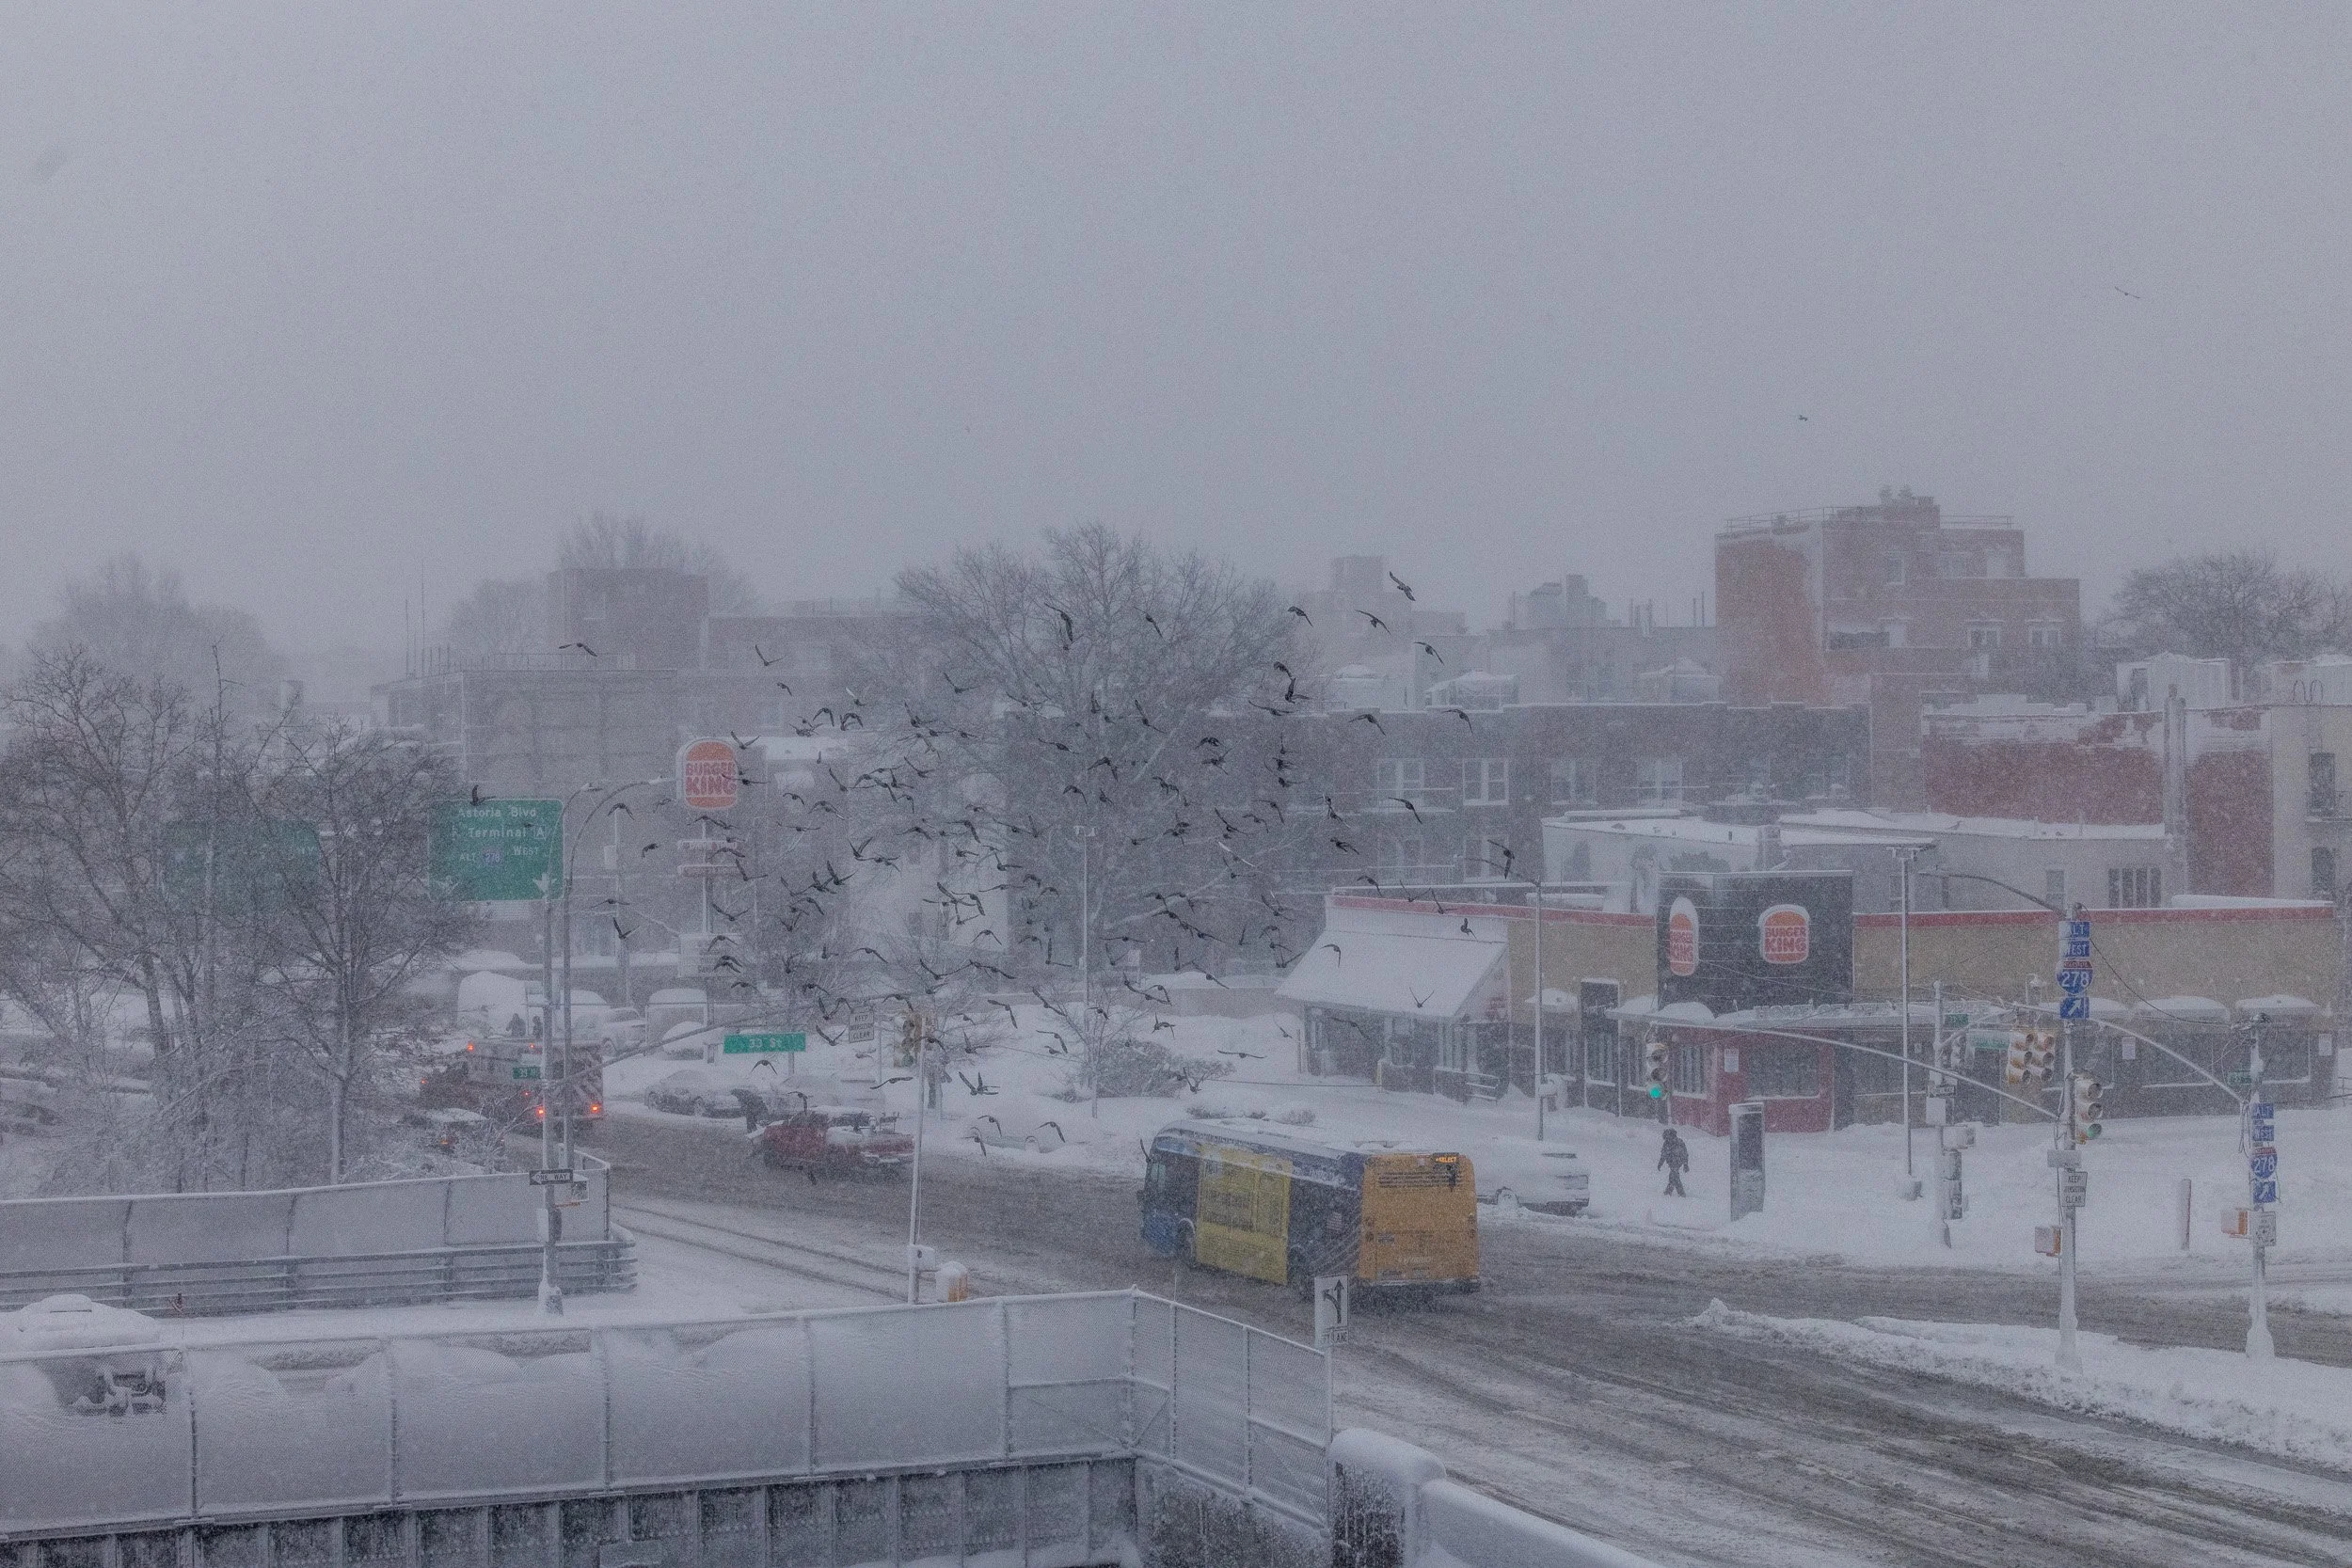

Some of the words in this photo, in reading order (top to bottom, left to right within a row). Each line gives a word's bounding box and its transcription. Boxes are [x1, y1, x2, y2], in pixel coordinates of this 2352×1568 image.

[686, 762, 736, 776] BURGER
[686, 776, 737, 795] KING
[458, 806, 501, 817] Astoria
[510, 806, 536, 816] Blvd
[469, 827, 527, 837] Terminal
[513, 847, 539, 856] WEST
[1764, 927, 1806, 938] BURGER
[1764, 938, 1806, 952] KING
[1670, 943, 1693, 961] KING
[2061, 972, 2090, 988] 278
[852, 1031, 870, 1039] CLEAR
[749, 1038, 763, 1048] 33
[2256, 1105, 2270, 1116] ALT
[2253, 1129, 2273, 1139] WEST
[2253, 1156, 2275, 1173] 278
